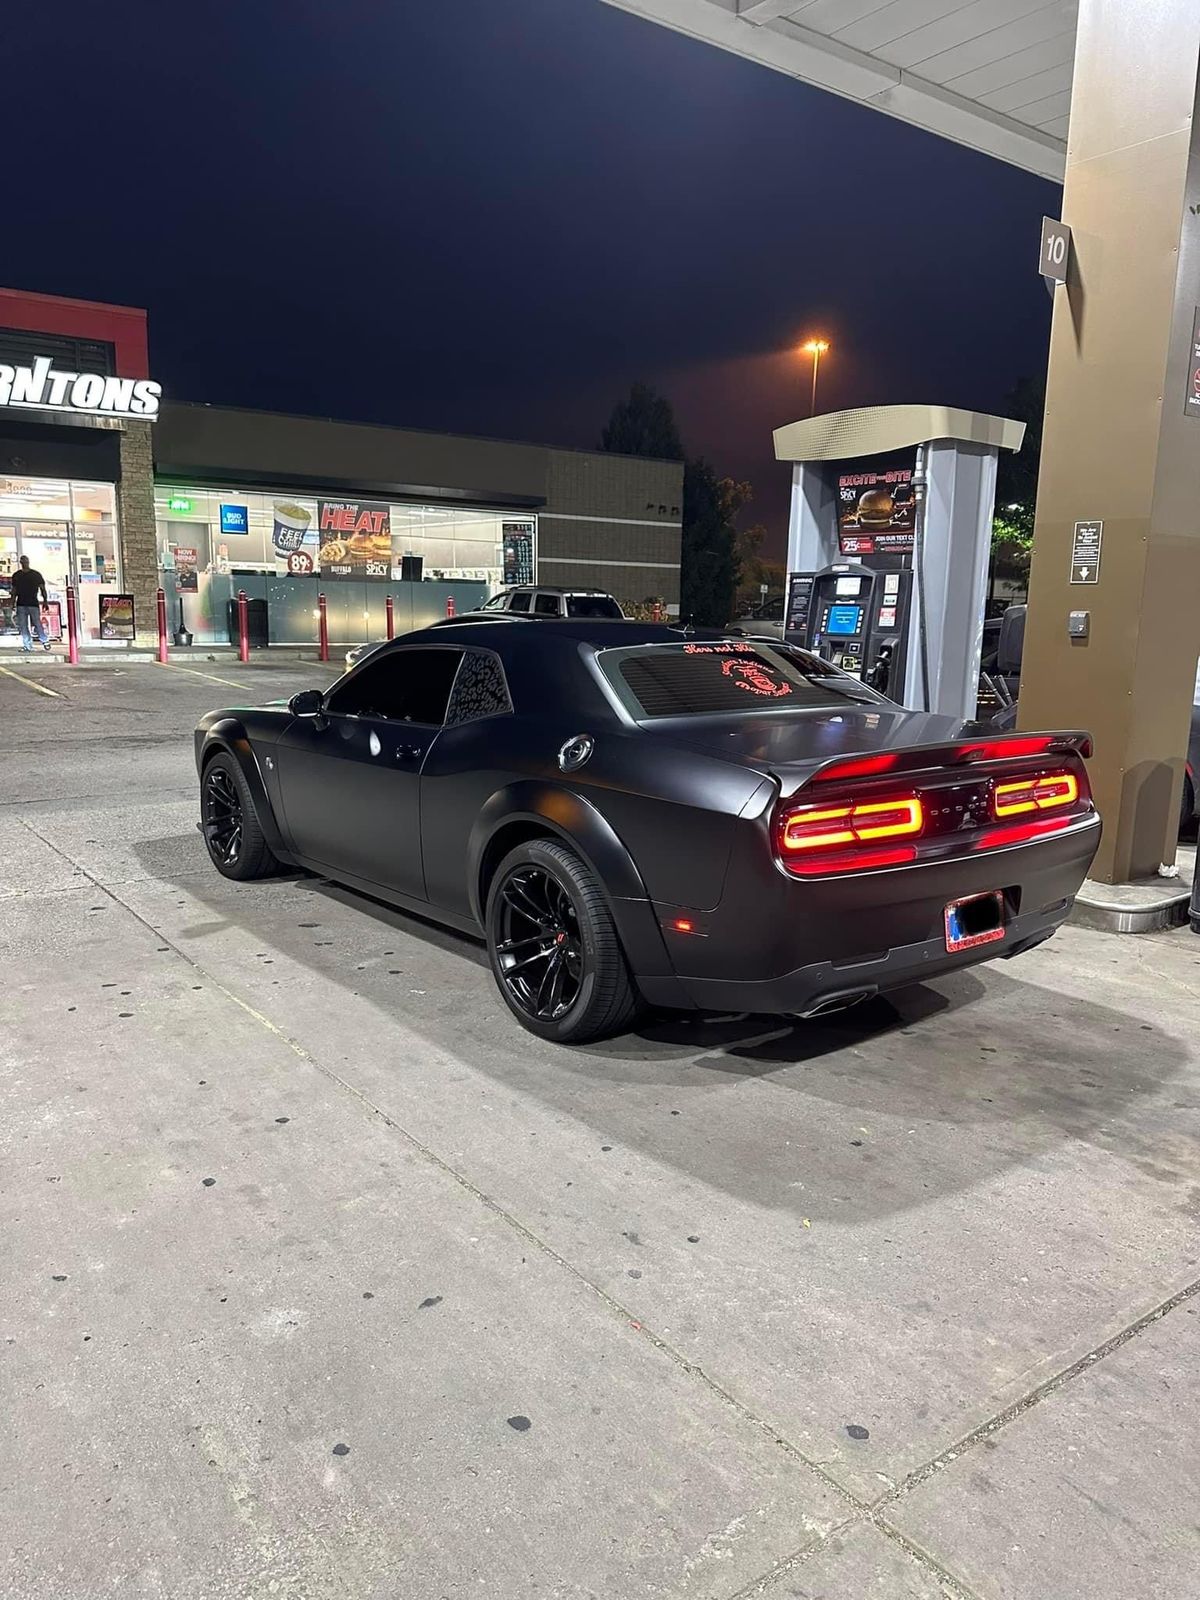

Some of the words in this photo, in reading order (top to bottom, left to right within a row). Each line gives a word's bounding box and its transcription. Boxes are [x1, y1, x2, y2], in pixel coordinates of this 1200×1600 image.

[1047, 234, 1065, 264] 10
[839, 473, 877, 487] EXCITE
[885, 470, 912, 483] BITE
[323, 502, 344, 511] BRING
[320, 509, 388, 532] HEAT
[280, 527, 303, 540] FEEL
[366, 563, 388, 574] SPICY
[715, 643, 734, 653] not
